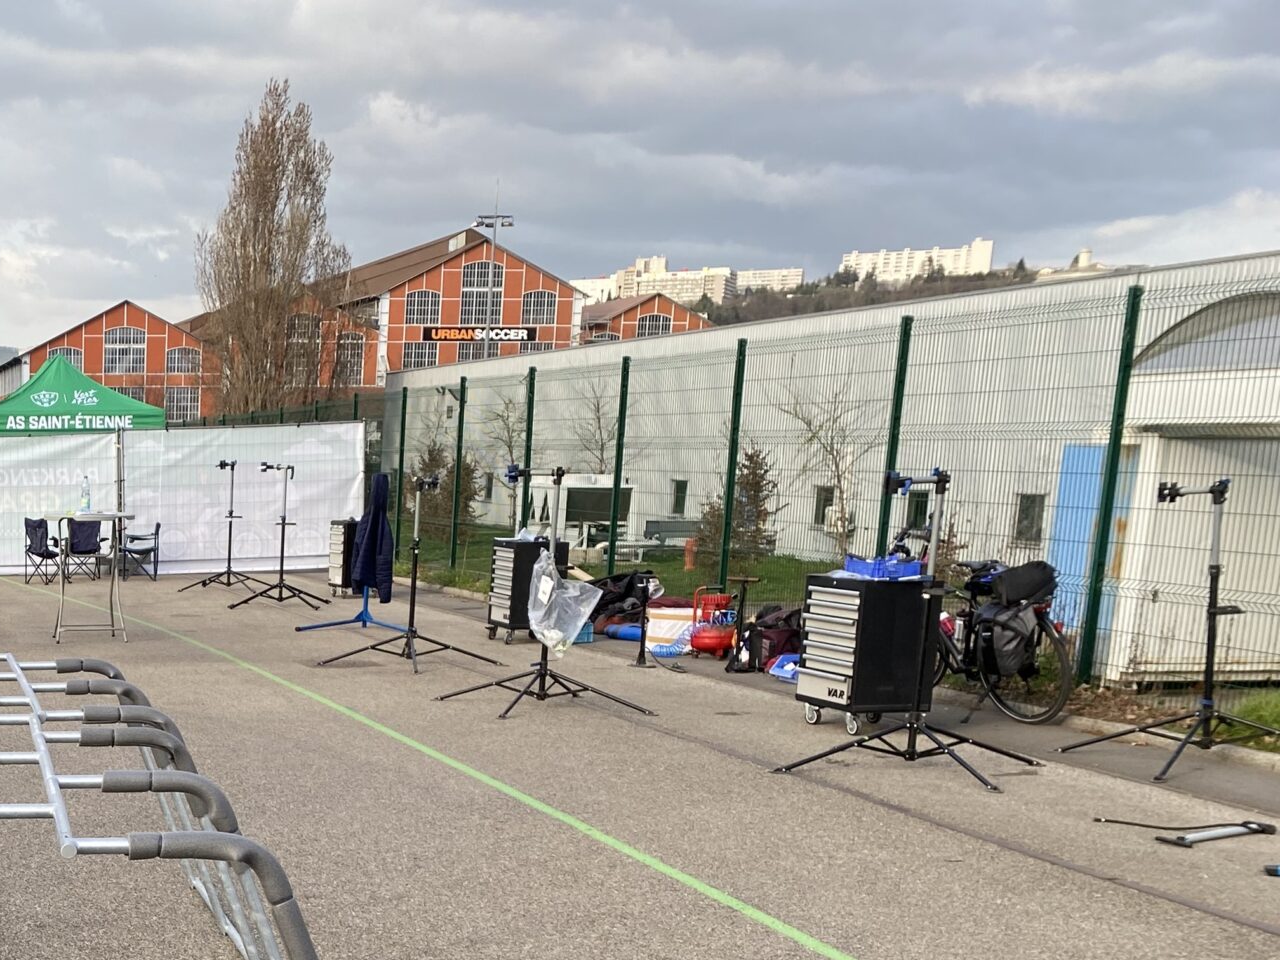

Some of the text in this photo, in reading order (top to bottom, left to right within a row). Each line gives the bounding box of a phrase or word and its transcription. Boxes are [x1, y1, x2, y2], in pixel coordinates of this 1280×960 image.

[6, 412, 134, 430] AS SAINT-ÉTIENNE
[826, 687, 846, 700] VAR
